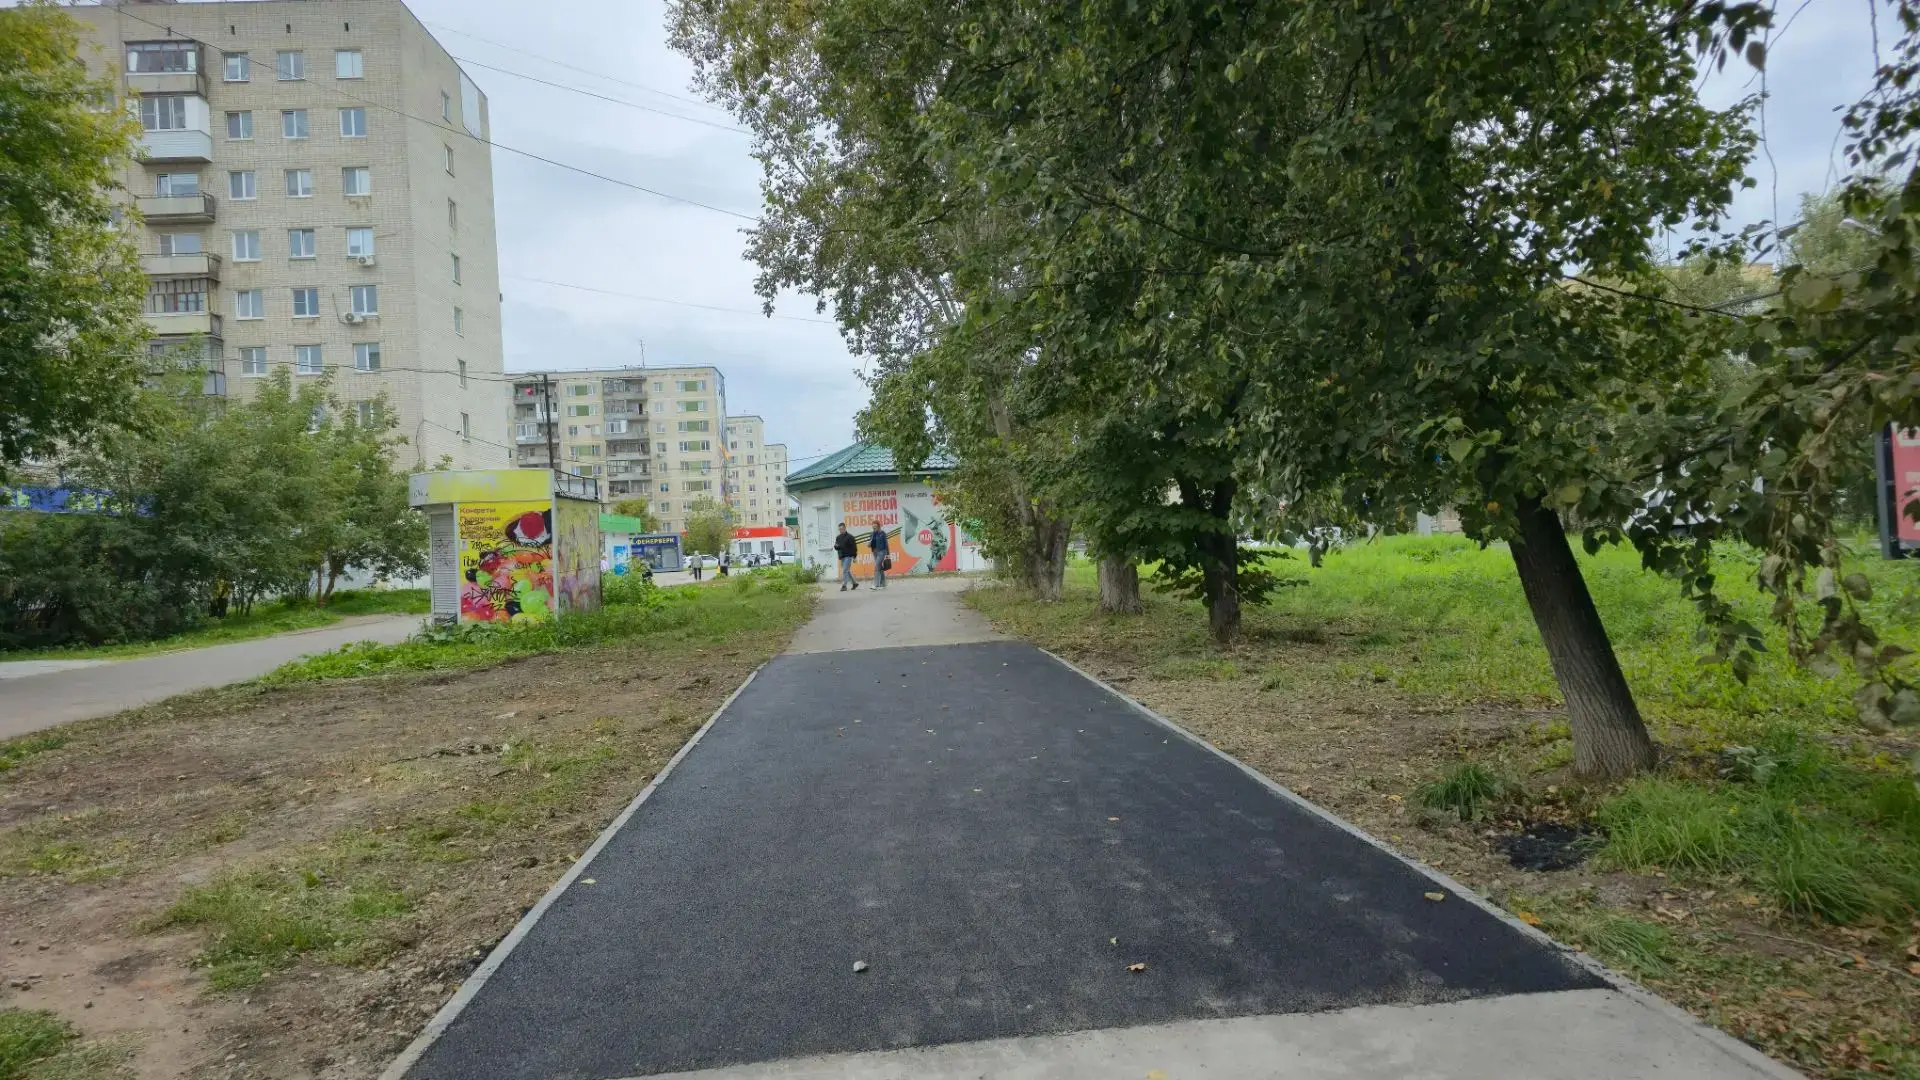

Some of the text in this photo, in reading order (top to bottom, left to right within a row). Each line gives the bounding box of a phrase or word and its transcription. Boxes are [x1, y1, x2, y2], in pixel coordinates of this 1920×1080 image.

[849, 490, 897, 498] ПРАЗДНИКОМ
[843, 497, 898, 512] ВЕЛИКОЙ
[844, 513, 898, 527] ПОБЕДЫ!
